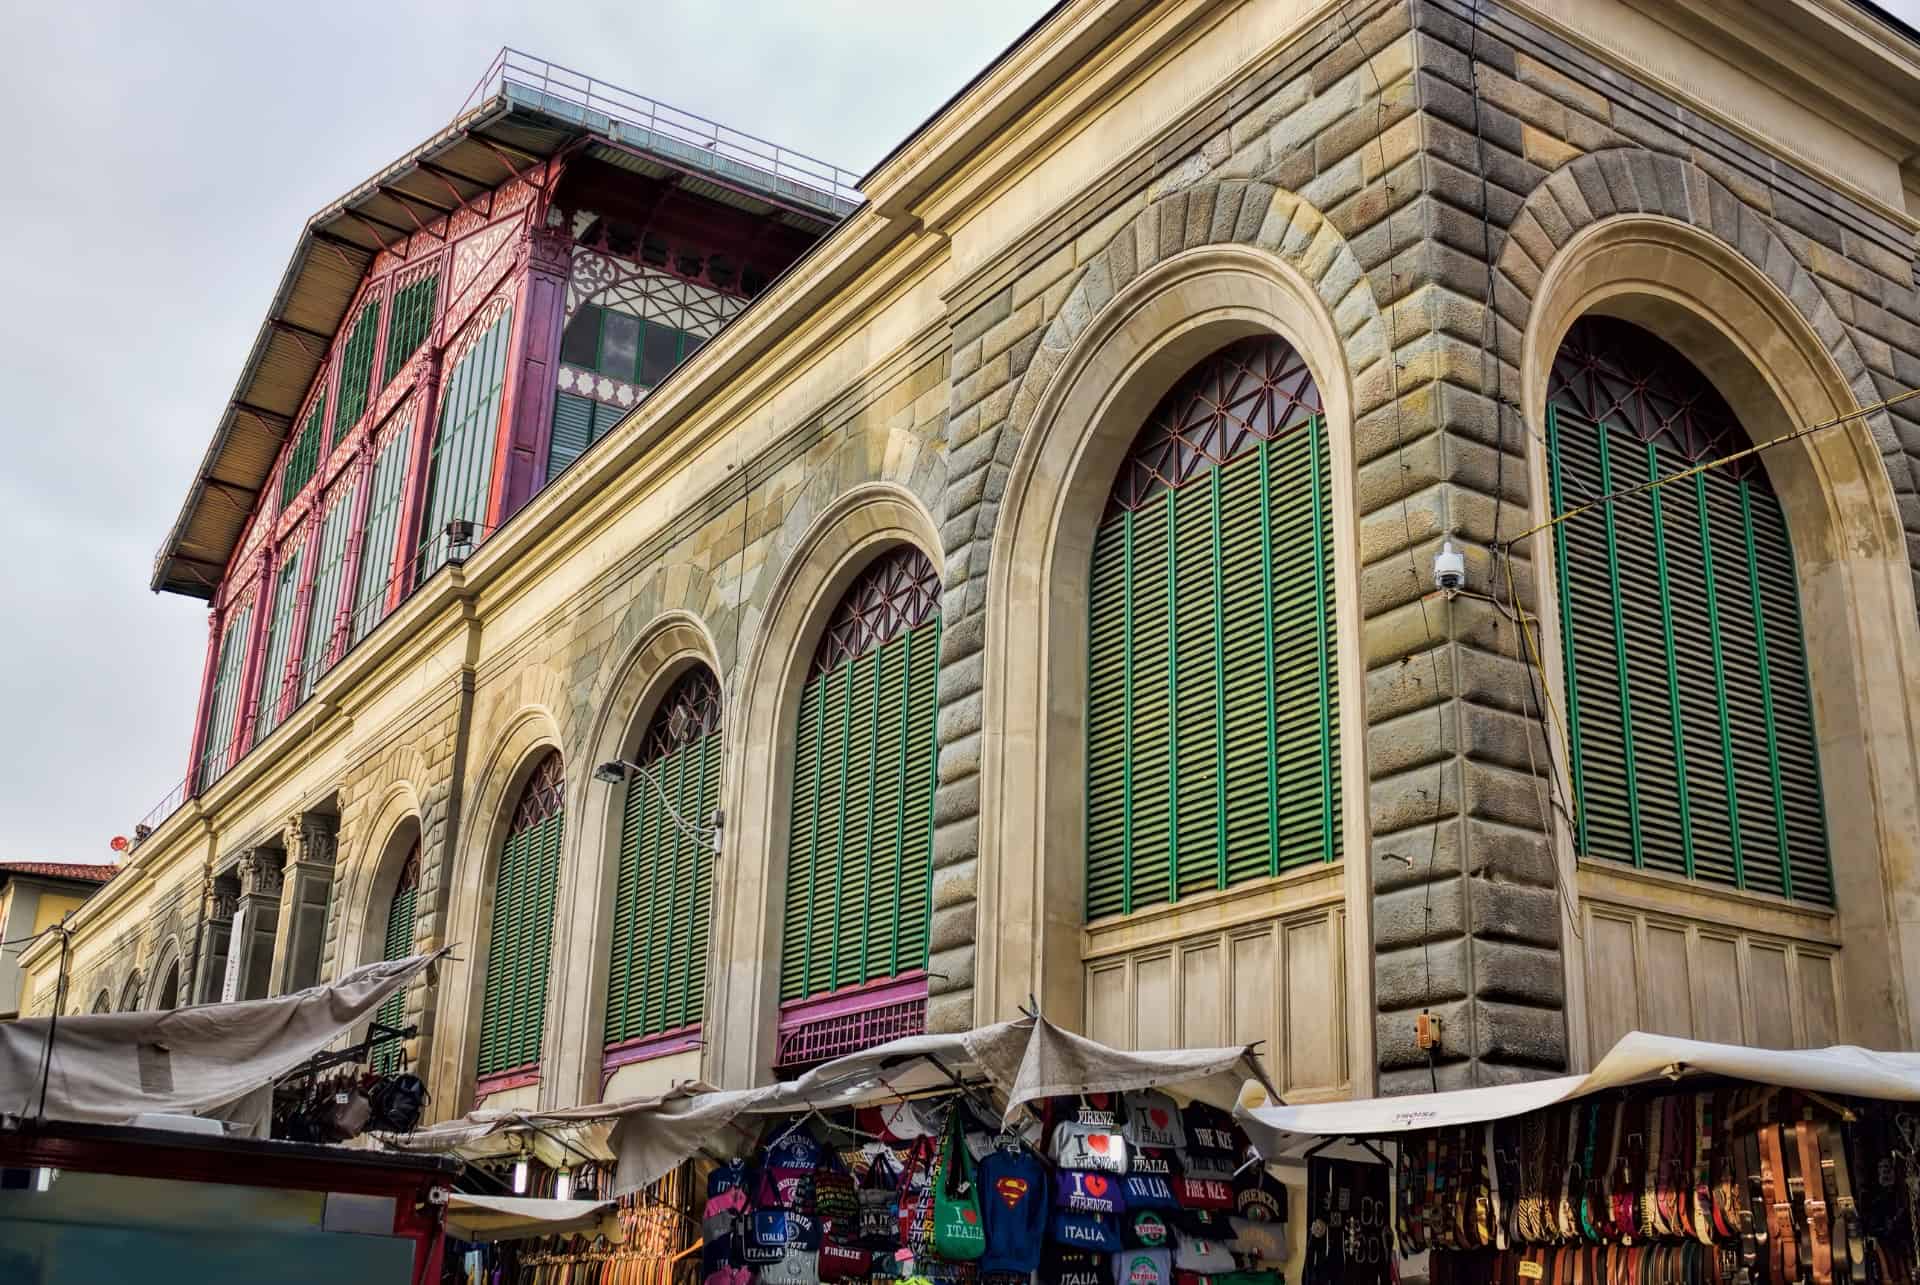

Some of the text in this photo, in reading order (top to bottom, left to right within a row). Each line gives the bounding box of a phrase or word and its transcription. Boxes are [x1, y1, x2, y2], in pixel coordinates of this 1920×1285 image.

[1074, 1134, 1088, 1156] I
[1133, 1160, 1170, 1174] ITALIA
[1072, 1172, 1085, 1196] I
[1070, 1196, 1113, 1214] FIRENZE
[953, 1206, 963, 1224] I
[761, 1232, 785, 1242] ITALIA
[946, 1224, 985, 1242] ITALIA
[1064, 1225, 1104, 1242] ITALIA
[746, 1247, 783, 1258] ITALIA
[823, 1246, 863, 1261] FIRENZE
[1060, 1271, 1100, 1285] ITALIA
